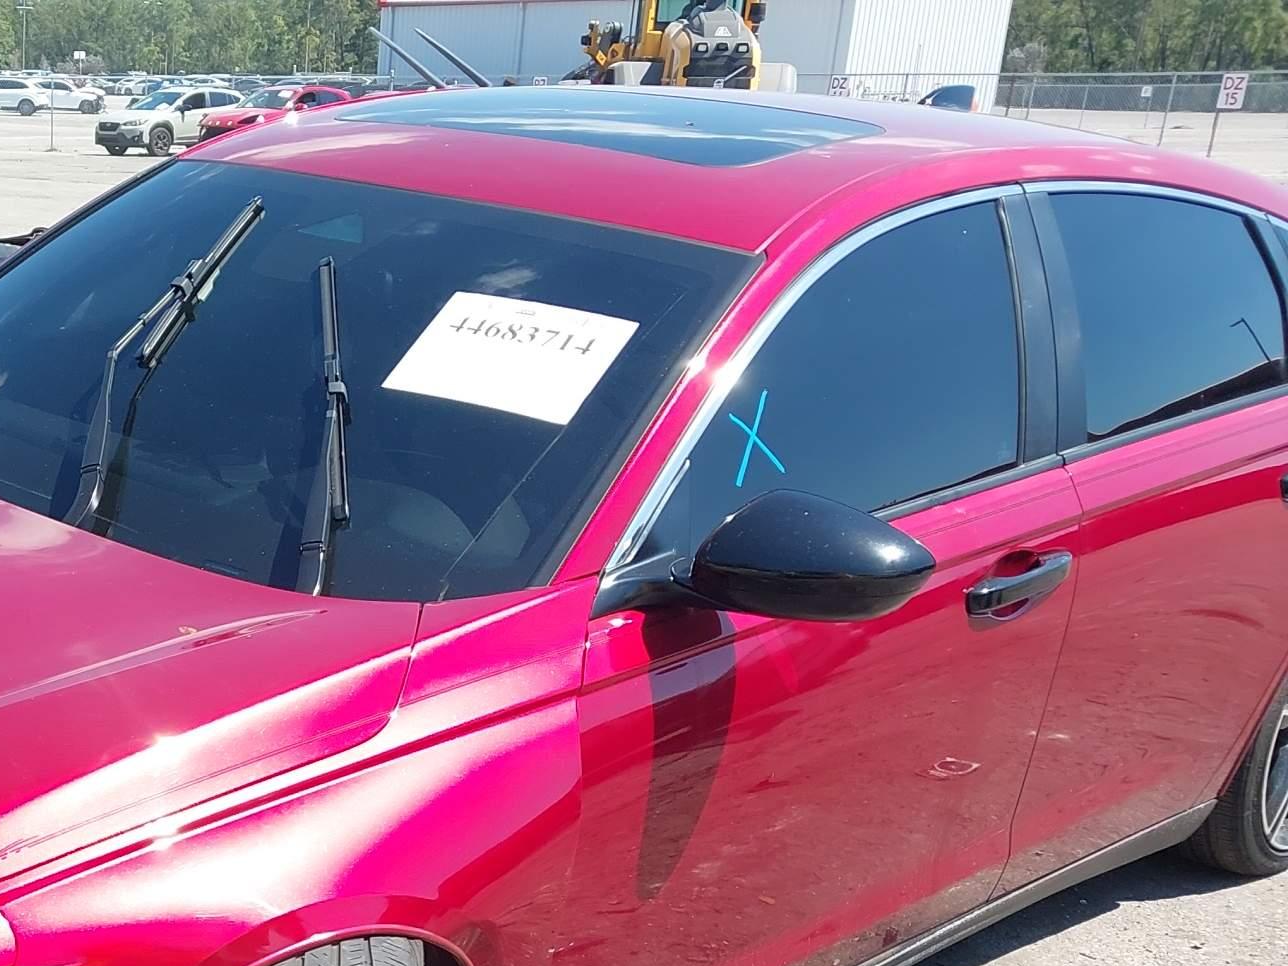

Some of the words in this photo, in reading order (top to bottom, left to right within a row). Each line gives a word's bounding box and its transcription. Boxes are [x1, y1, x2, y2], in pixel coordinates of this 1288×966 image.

[832, 77, 848, 89] DZ
[1223, 77, 1246, 90] DZ
[1224, 92, 1238, 105] 15
[449, 317, 596, 355] 44683714
